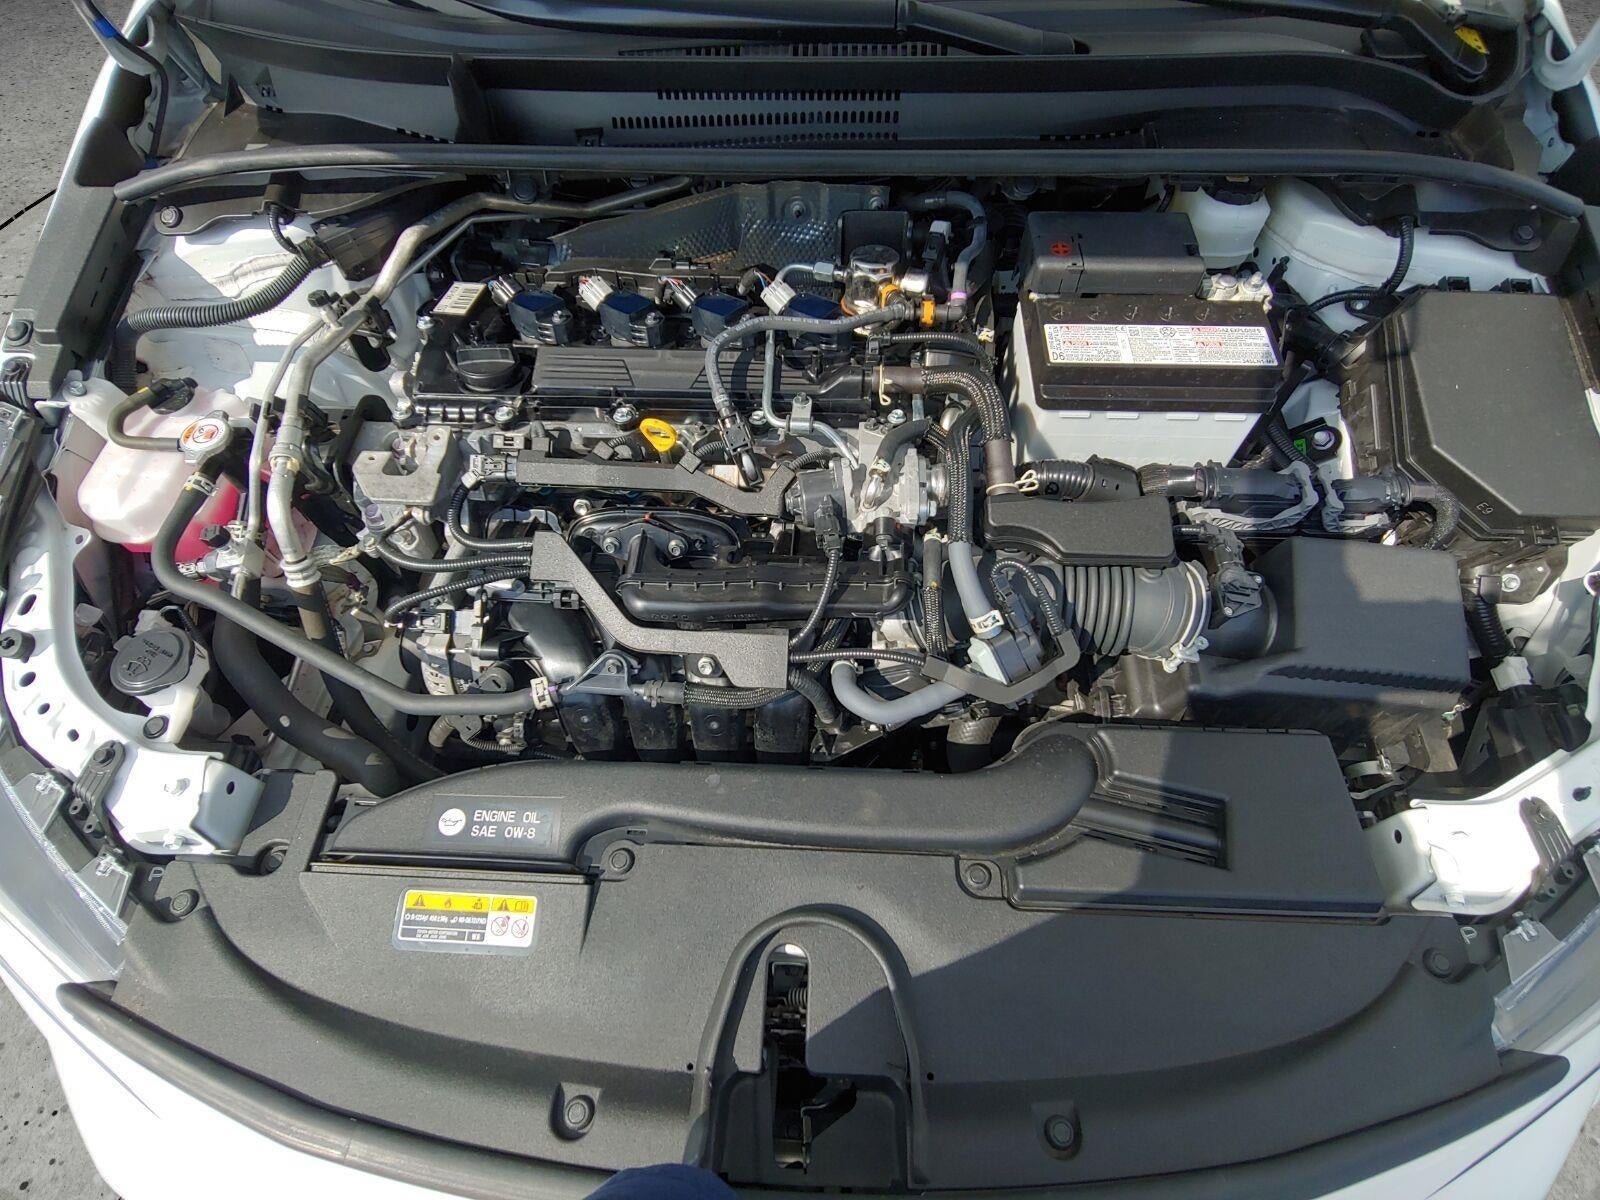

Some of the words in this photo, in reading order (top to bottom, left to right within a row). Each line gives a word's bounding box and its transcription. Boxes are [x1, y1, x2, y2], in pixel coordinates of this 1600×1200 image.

[1052, 351, 1065, 361] D6
[474, 809, 516, 823] ENGINE
[522, 811, 541, 824] OIL
[470, 824, 497, 838] SAE
